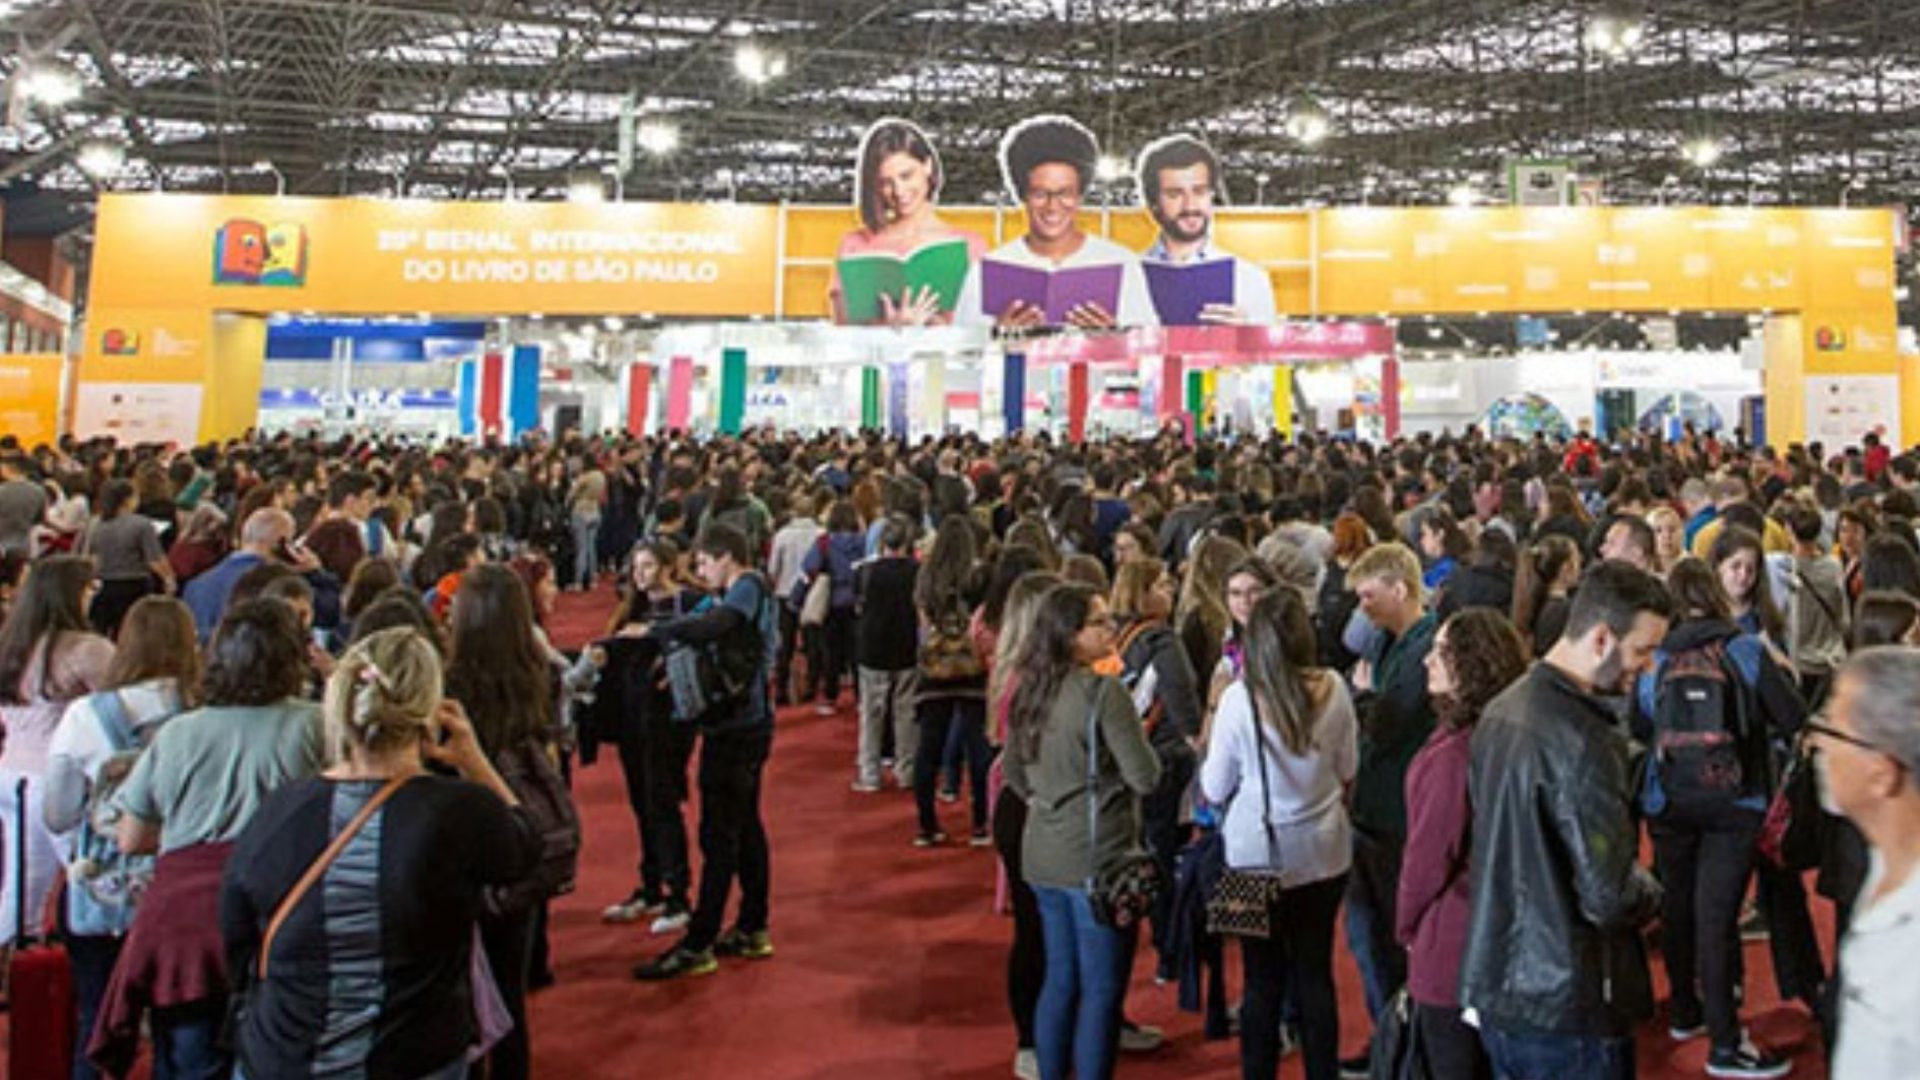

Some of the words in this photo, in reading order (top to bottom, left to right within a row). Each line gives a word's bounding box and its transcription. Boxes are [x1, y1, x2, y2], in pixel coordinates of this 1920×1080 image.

[425, 231, 518, 252] BIENAL
[530, 231, 742, 253] INTERNACIONAL
[402, 259, 445, 282] DO
[450, 259, 528, 282] LIVRO
[534, 259, 566, 282] DE
[573, 256, 629, 282] SÃO
[633, 259, 719, 282] PAULO
